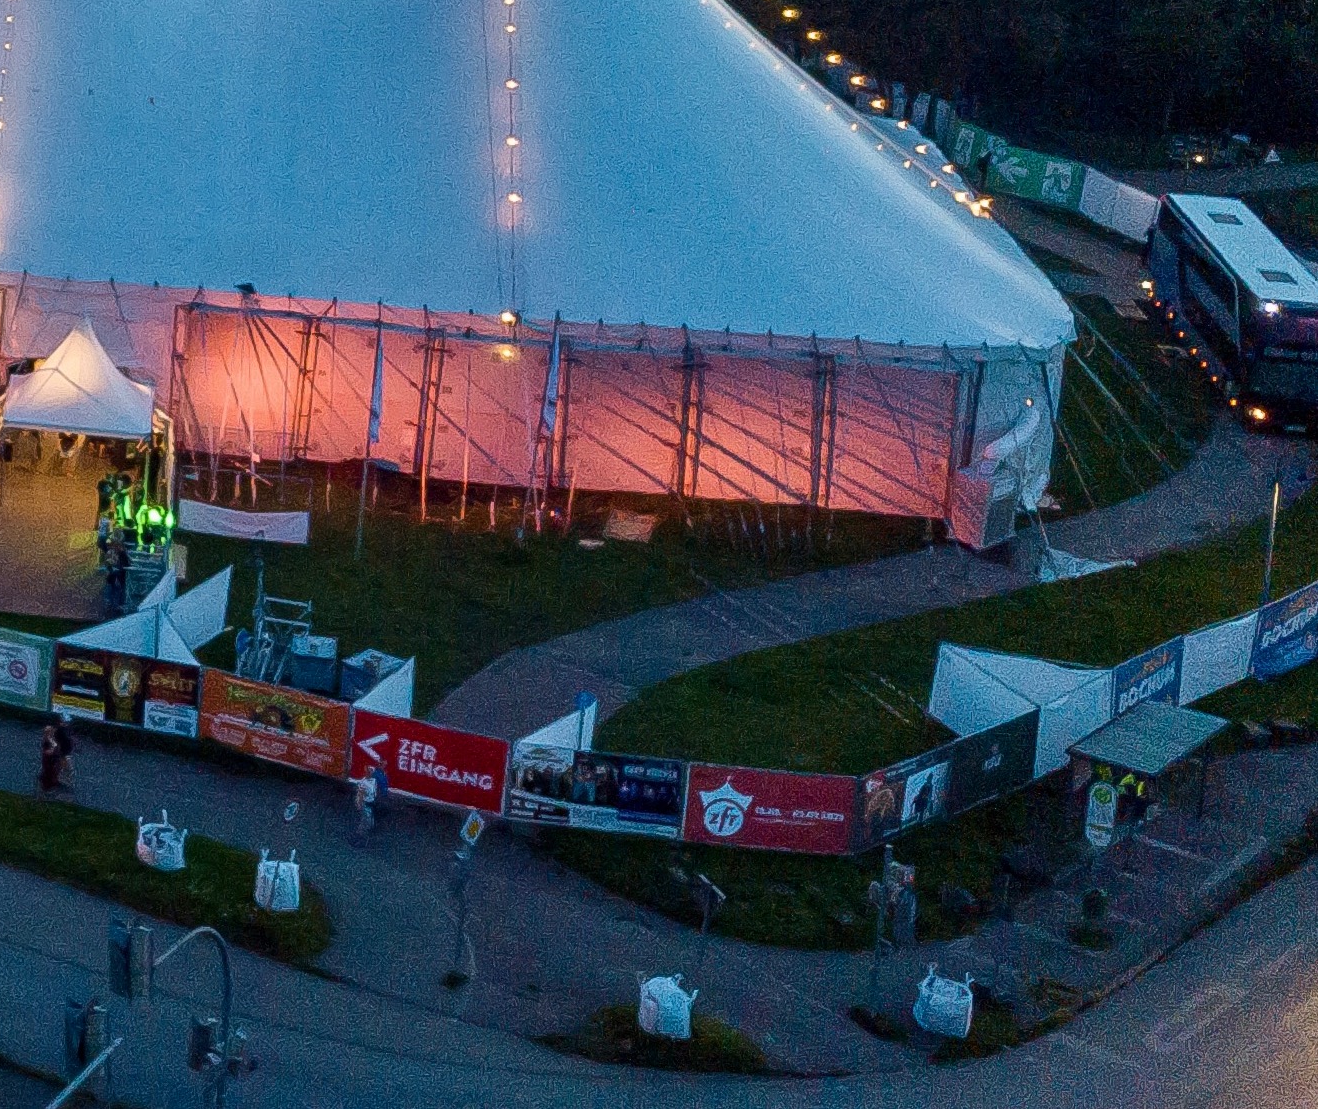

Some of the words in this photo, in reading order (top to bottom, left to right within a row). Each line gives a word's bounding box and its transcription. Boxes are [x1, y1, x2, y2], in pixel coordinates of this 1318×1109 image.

[398, 738, 438, 761] ZFR
[397, 755, 494, 791] EINGANG
[709, 805, 739, 832] zfr
